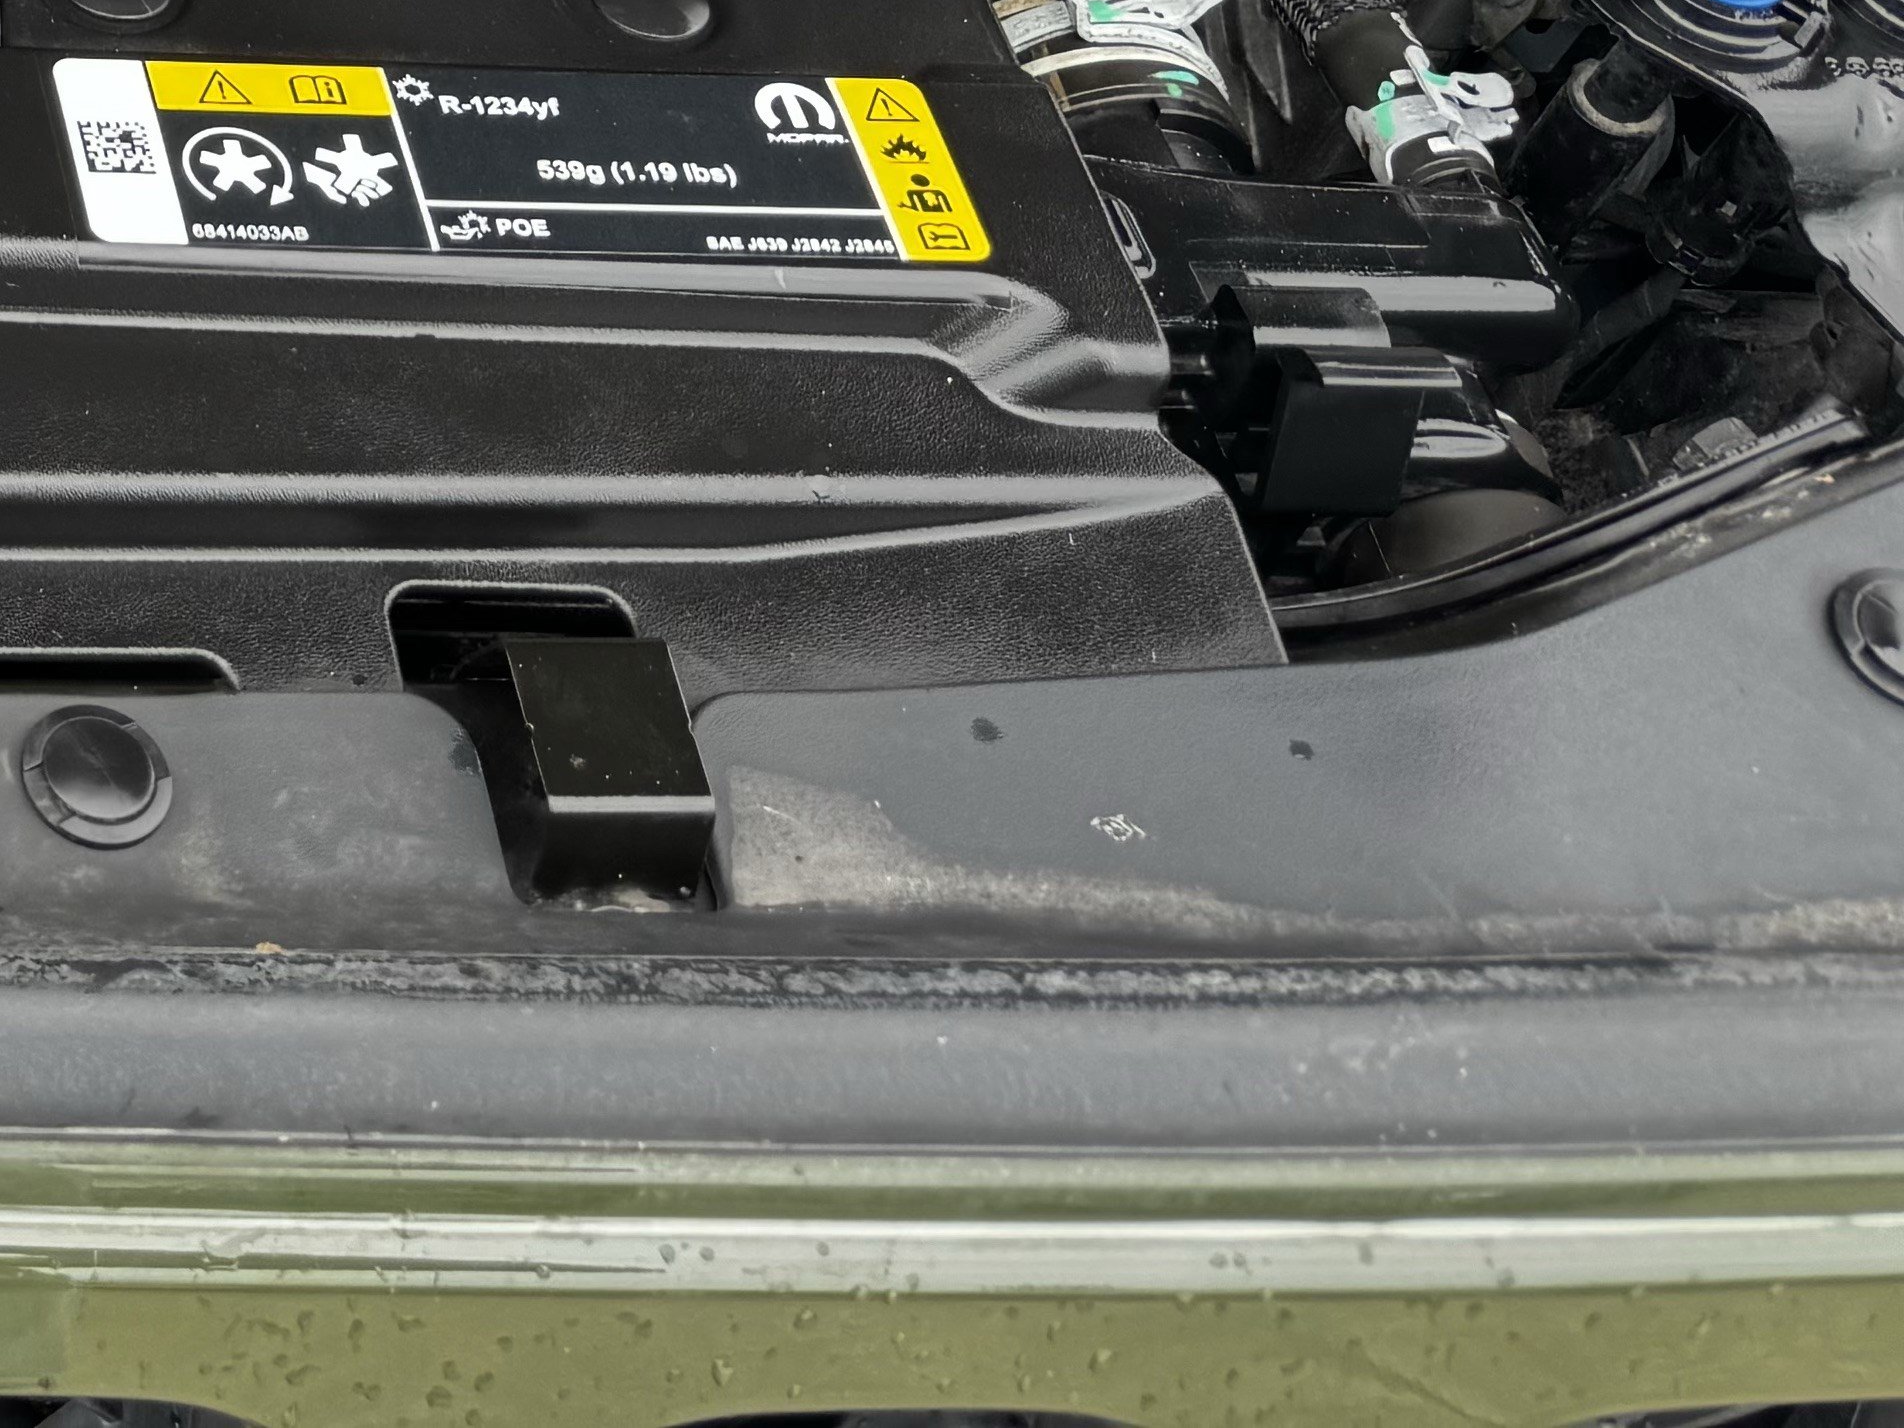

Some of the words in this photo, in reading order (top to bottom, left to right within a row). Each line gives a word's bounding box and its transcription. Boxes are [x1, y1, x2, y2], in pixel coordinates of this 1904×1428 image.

[438, 95, 560, 120] R-1234yf
[537, 159, 605, 185] 539g
[611, 161, 677, 185] (1.19
[682, 163, 738, 188] lbs)
[192, 223, 309, 241] 68414033AB
[496, 218, 551, 237] POE
[706, 235, 744, 251] SAE
